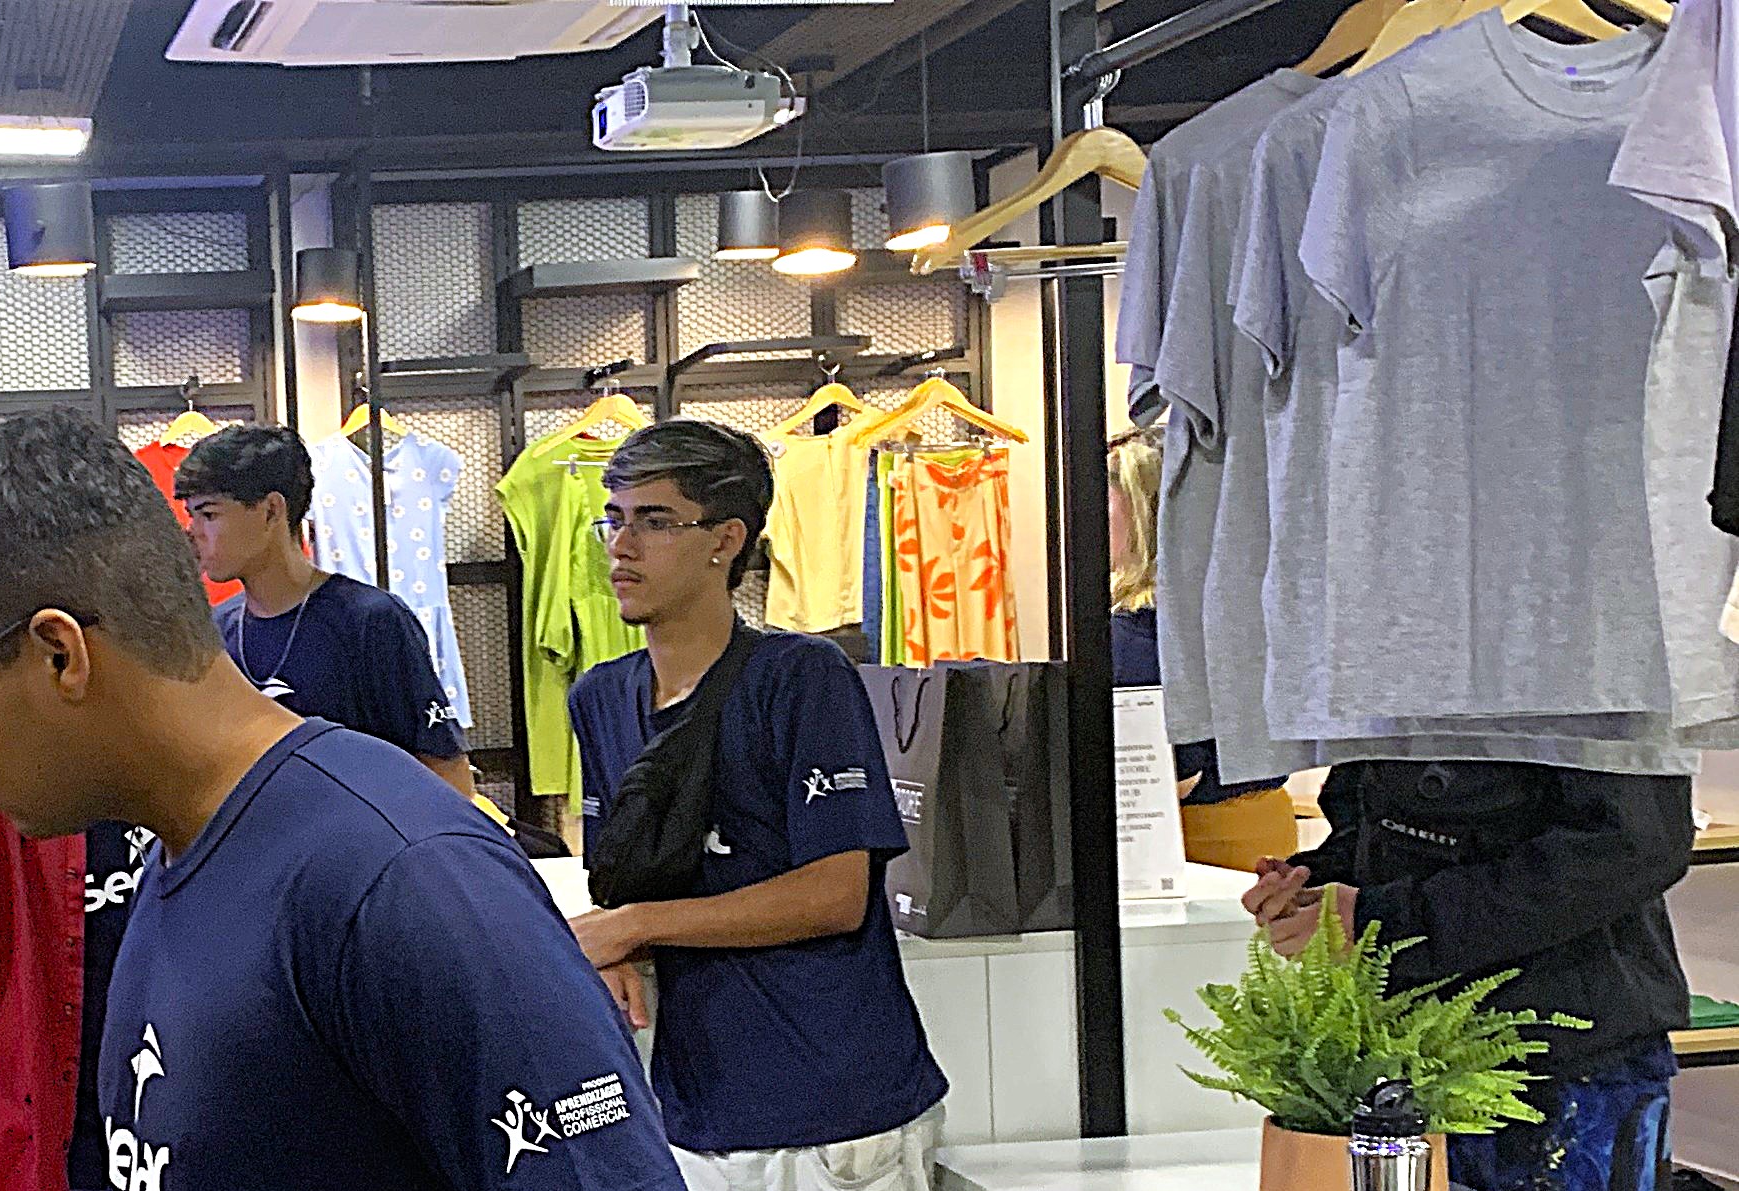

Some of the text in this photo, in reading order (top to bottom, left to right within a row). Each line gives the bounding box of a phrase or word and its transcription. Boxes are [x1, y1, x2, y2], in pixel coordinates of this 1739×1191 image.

[84, 866, 145, 912] Se
[558, 1095, 628, 1125] PROFISSIONAL
[562, 1105, 631, 1138] COMERCIAL
